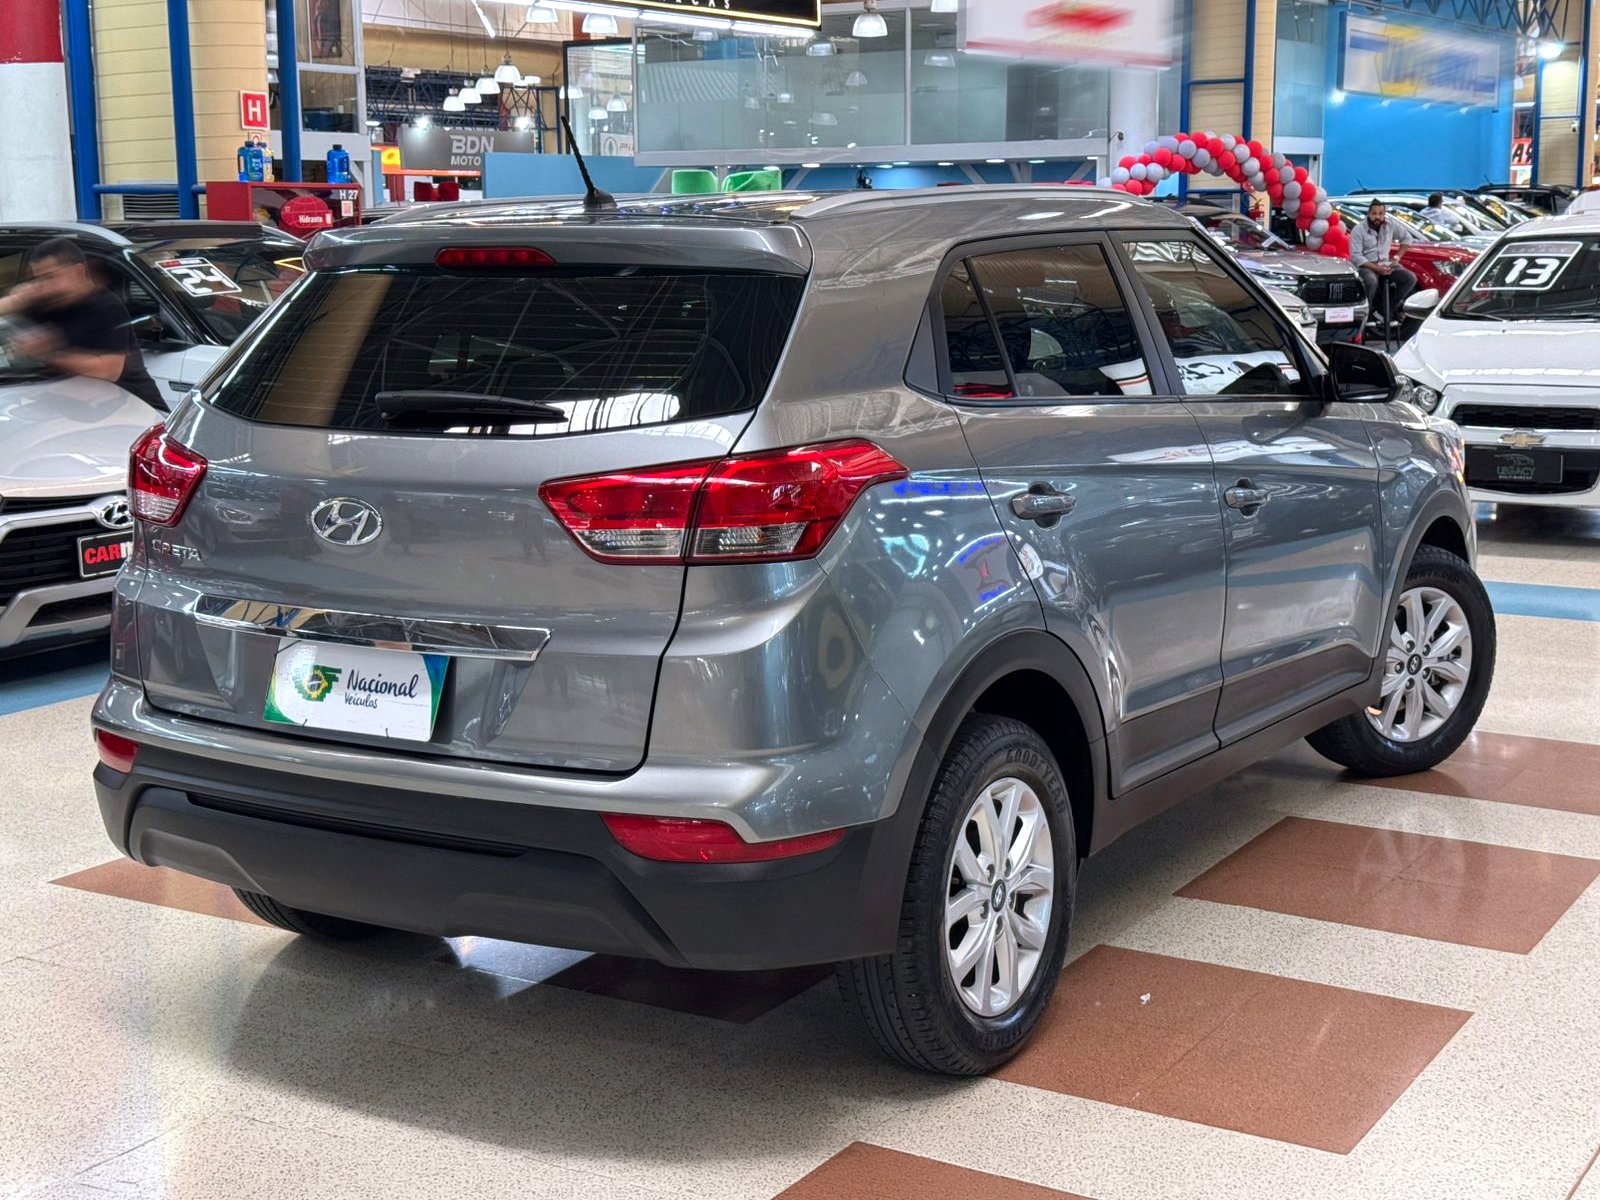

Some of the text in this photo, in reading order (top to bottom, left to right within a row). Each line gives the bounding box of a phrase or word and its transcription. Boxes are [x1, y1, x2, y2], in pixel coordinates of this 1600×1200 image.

[248, 99, 262, 122] H
[450, 135, 495, 154] BDN
[450, 156, 482, 167] MOTO
[340, 190, 359, 200] H 27
[298, 215, 323, 224] Hidrante
[171, 267, 235, 294] 24
[1505, 258, 1560, 286] 13
[152, 539, 201, 561] CRETA
[347, 669, 419, 698] Nacional
